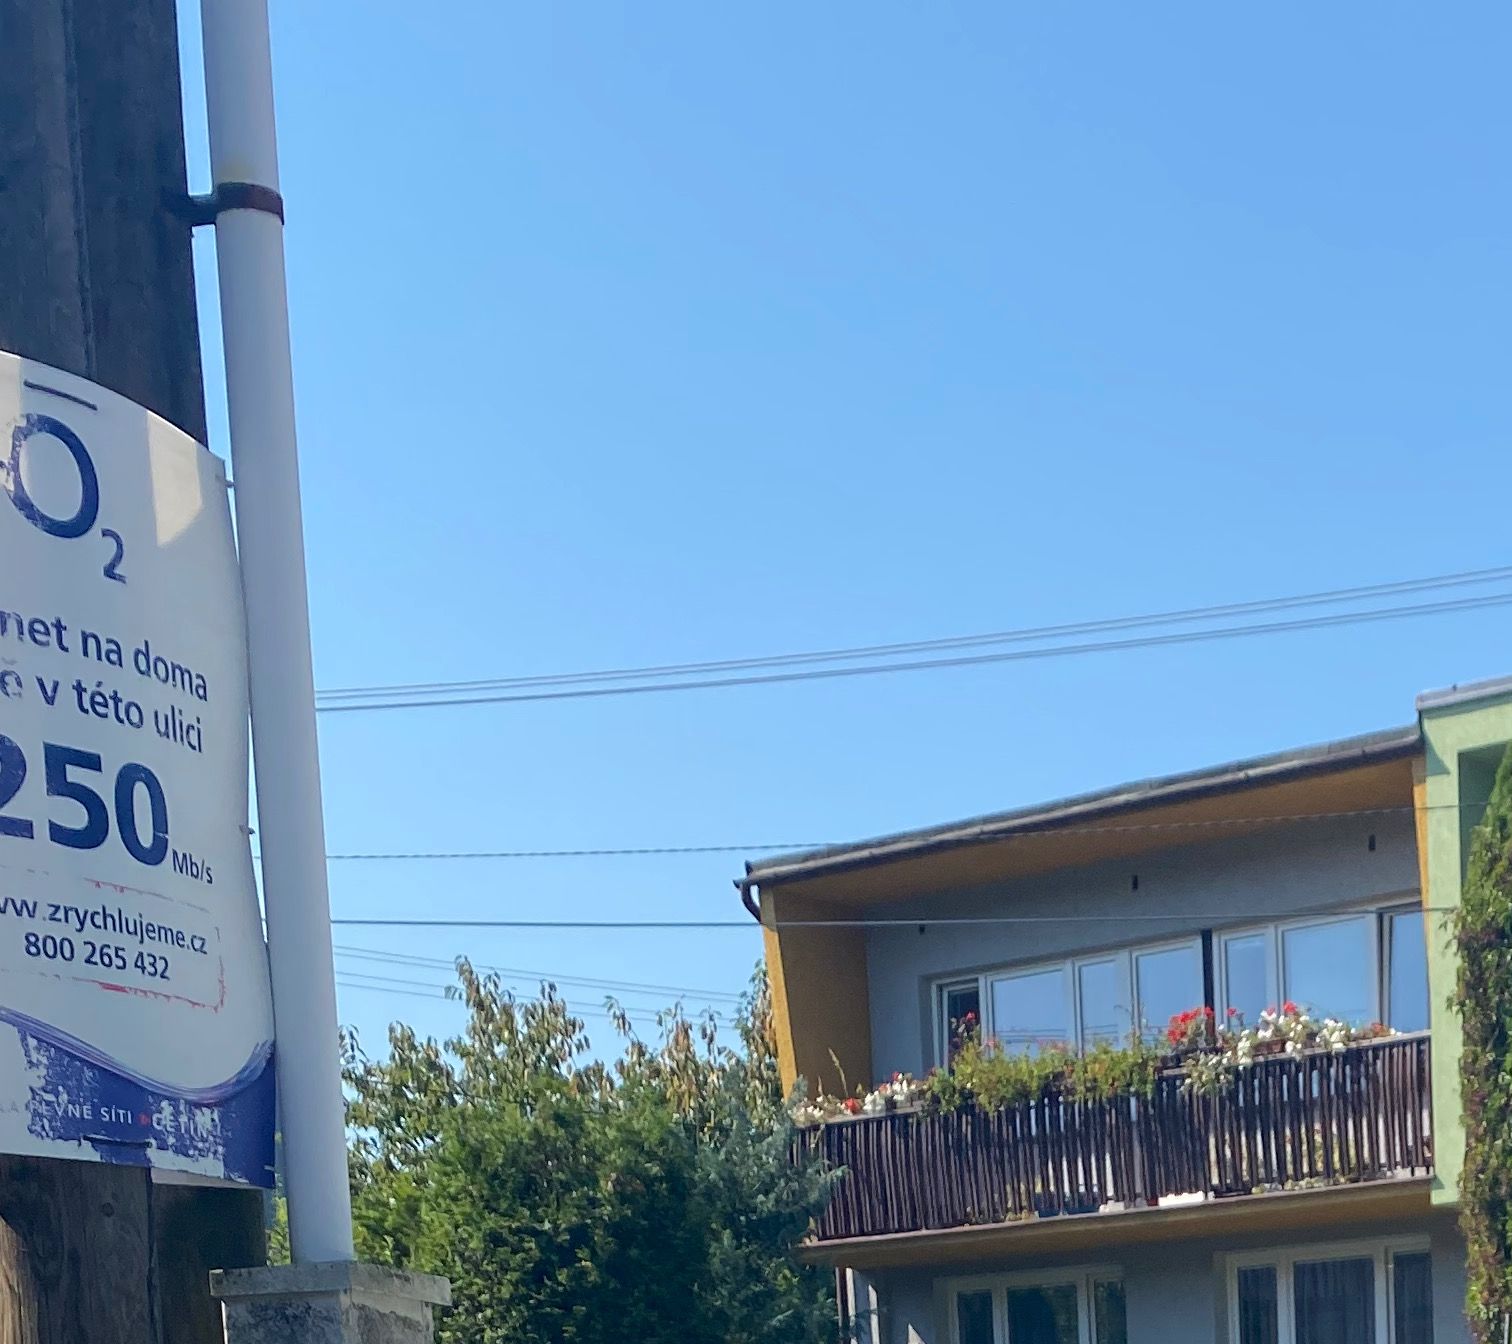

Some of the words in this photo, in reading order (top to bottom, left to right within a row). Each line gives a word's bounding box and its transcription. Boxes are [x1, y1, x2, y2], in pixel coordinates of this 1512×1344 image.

[80, 629, 123, 669] na
[133, 639, 208, 702] doma
[35, 675, 60, 707] v
[72, 678, 144, 729] této
[154, 704, 203, 753] ulici
[0, 733, 169, 866] 250
[171, 848, 213, 885] Mb/s
[24, 931, 75, 962] 800
[83, 940, 127, 970] 265
[134, 950, 170, 981] 432
[100, 1104, 132, 1124] SÍTI
